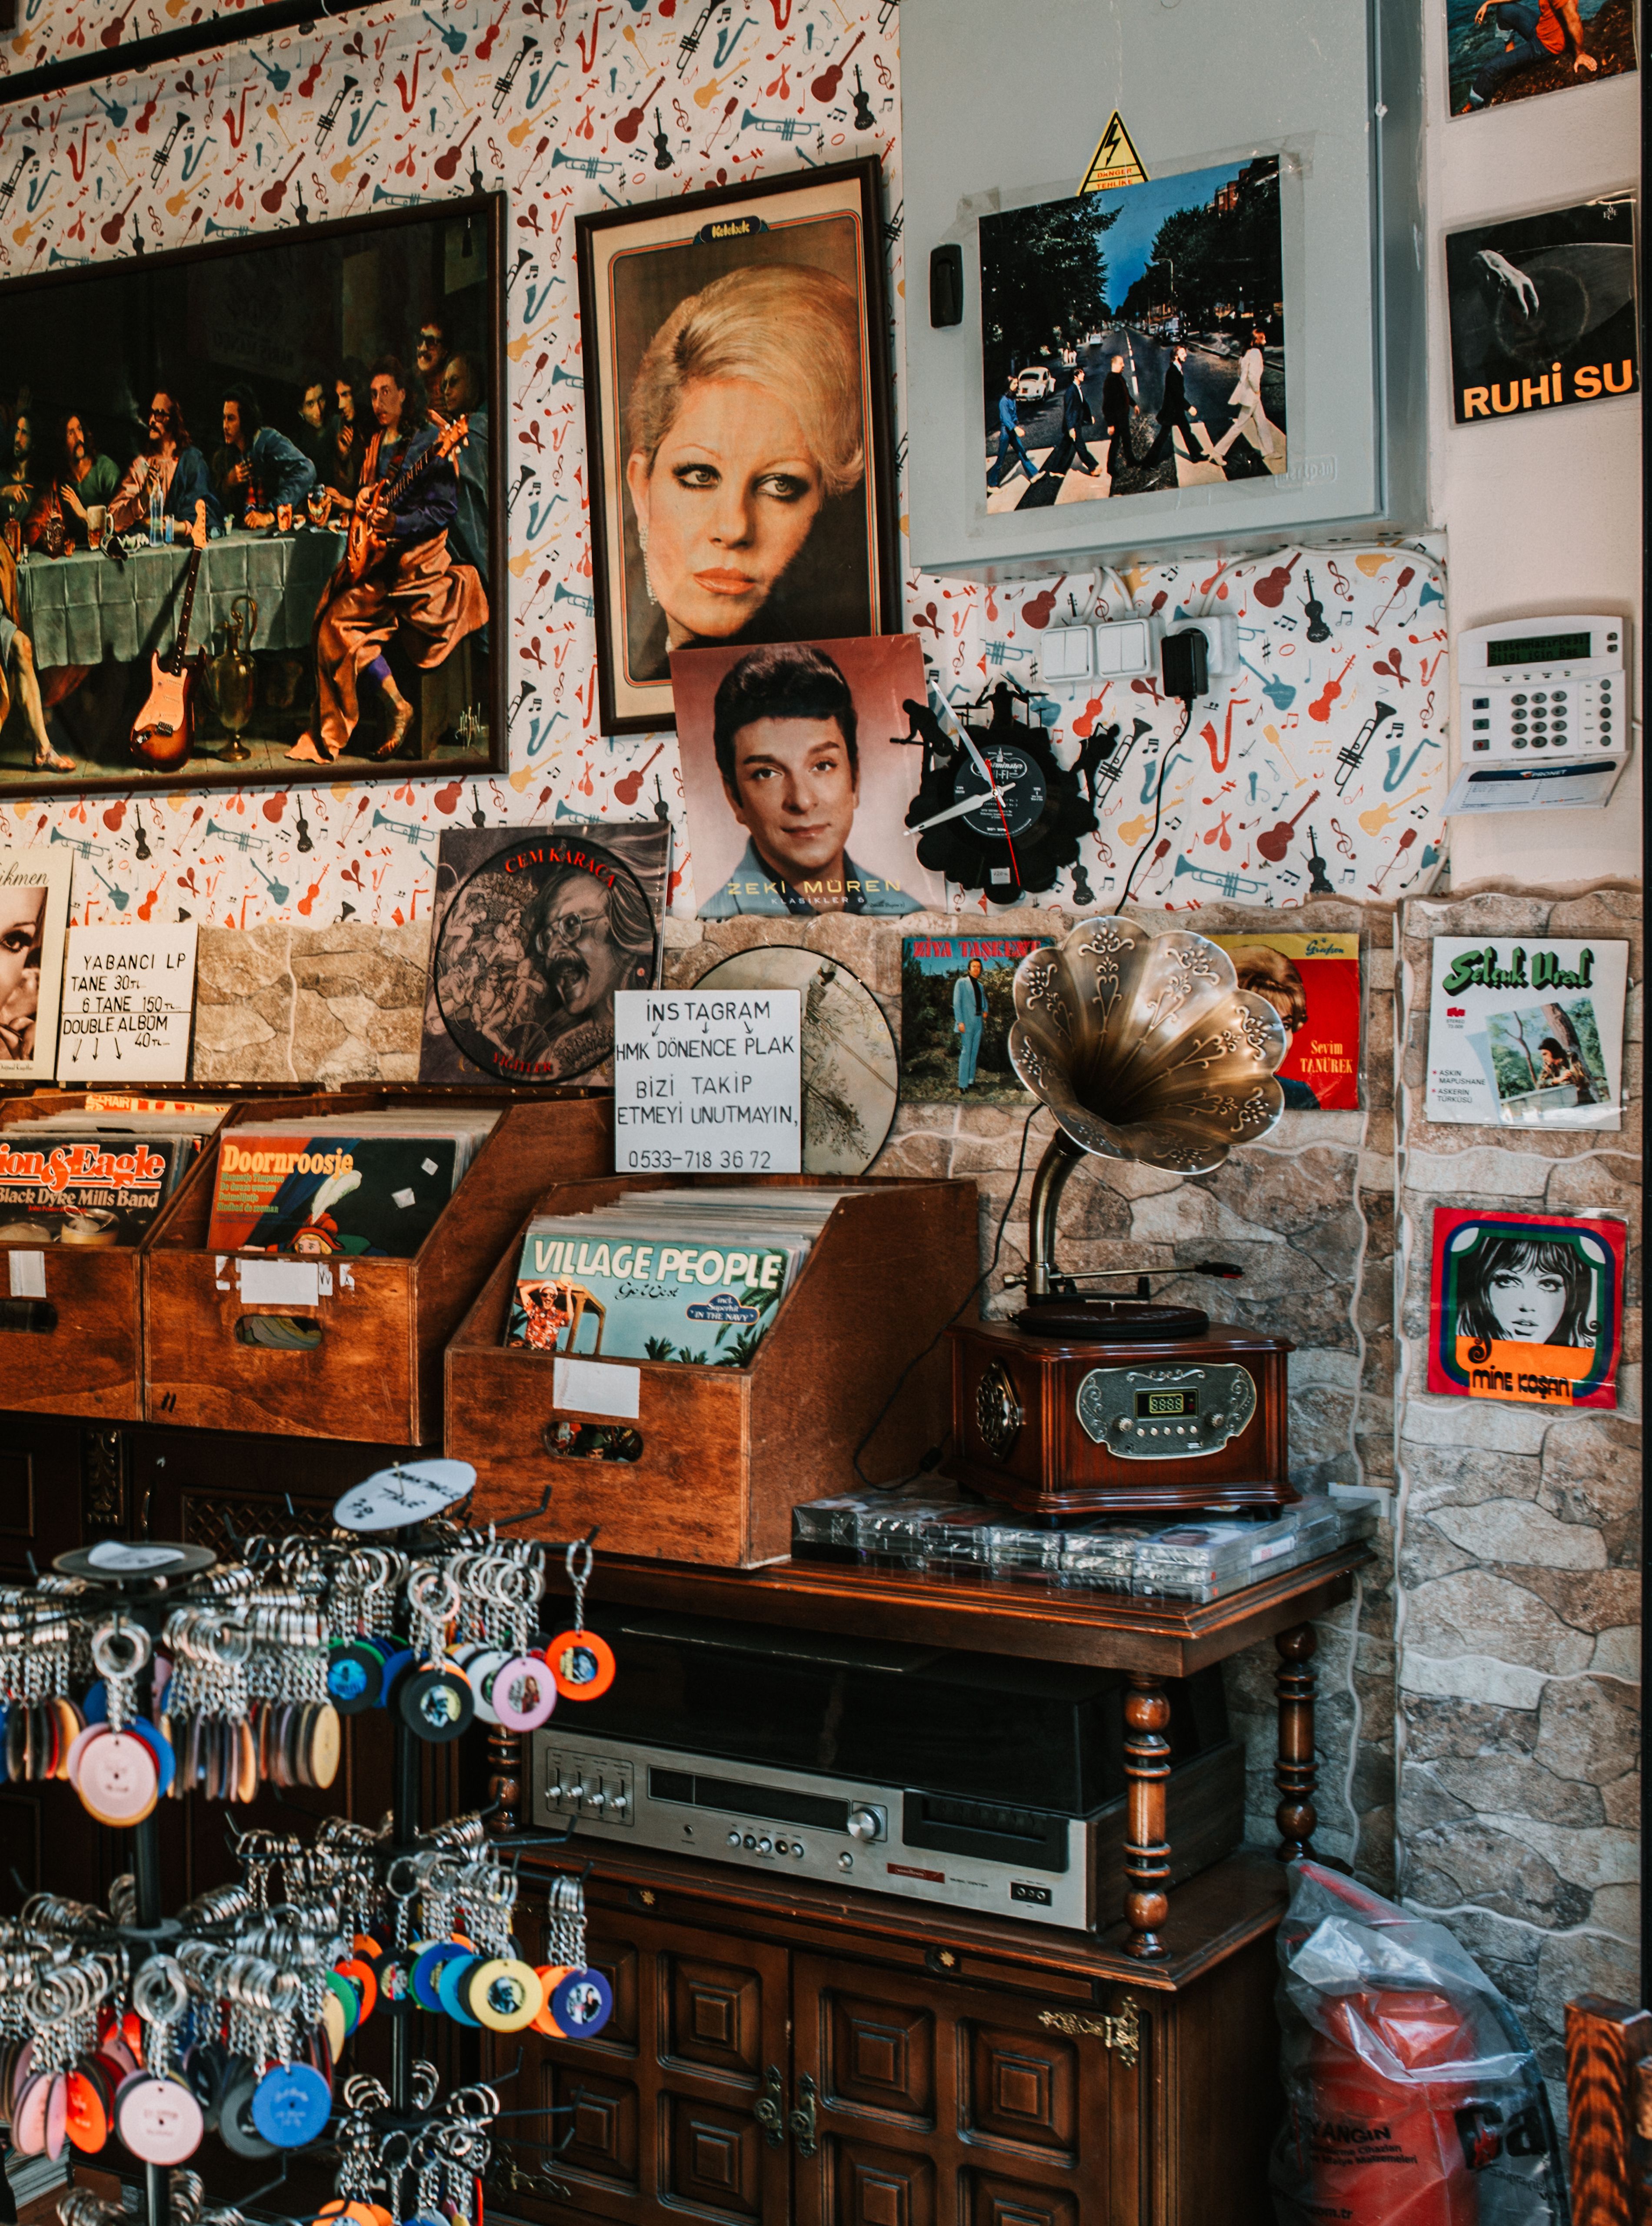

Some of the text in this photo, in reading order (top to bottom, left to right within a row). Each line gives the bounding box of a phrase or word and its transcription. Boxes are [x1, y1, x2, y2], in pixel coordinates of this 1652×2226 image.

[1097, 168, 1132, 178] DANGER
[712, 220, 750, 238] Kelebek
[1574, 359, 1633, 398] SU
[505, 848, 543, 873] CEM
[727, 880, 901, 895] ZEKİ MÜREN
[771, 896, 849, 905] KLASİKLER
[913, 936, 953, 957] ZİYA
[84, 953, 186, 970] YABANCI LP
[1442, 946, 1595, 996] Selçuk Ural
[71, 976, 108, 992] TANE
[82, 997, 90, 1013] 6
[96, 996, 132, 1013] TANE
[63, 1016, 115, 1035] DOUBLE
[616, 1036, 795, 1061] HMK DÖNENCE PLAK
[1310, 1040, 1343, 1055] Sevim
[636, 1071, 753, 1099] BİZİ TAKİP
[104, 1096, 130, 1109] HAIR
[617, 1101, 683, 1125] ETMEYİ
[221, 1145, 354, 1180] Doornroosje
[629, 1150, 771, 1169] 0533-718 36 72
[37, 1188, 76, 1206] Dyke
[78, 1189, 116, 1206] Mills
[117, 1191, 160, 1207] Band
[535, 1240, 783, 1289] VILLAGE PEOPLE
[615, 1282, 679, 1300] Go West
[706, 1311, 723, 1320] THE
